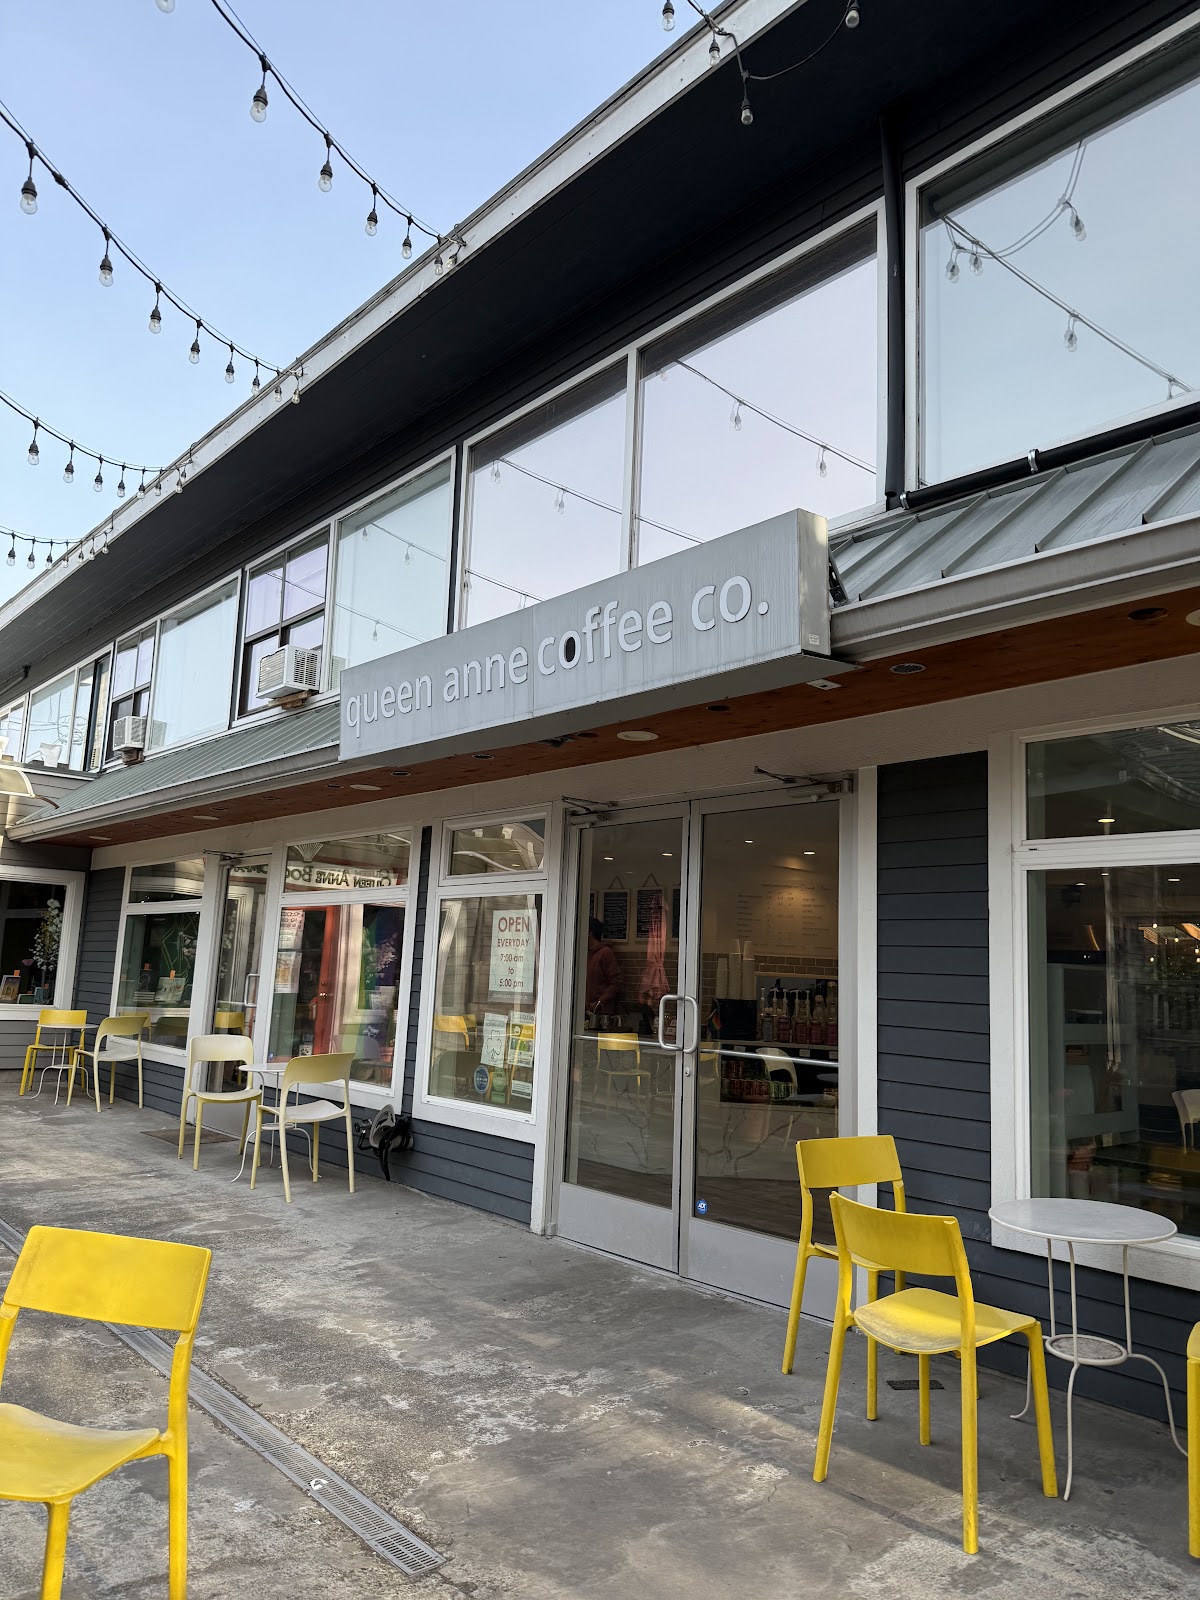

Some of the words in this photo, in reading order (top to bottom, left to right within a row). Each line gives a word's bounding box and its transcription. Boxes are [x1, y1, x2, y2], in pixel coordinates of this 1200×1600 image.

[346, 674, 432, 738] queen
[443, 646, 528, 702] anne
[538, 600, 673, 676] coffee
[691, 575, 769, 631] co.
[498, 916, 530, 933] OPEN
[497, 938, 530, 948] EVERYDAY
[500, 954, 512, 963] 7:00
[513, 955, 524, 963] am
[507, 967, 515, 975] to
[499, 979, 512, 988] 5:00
[513, 980, 524, 989] pm
